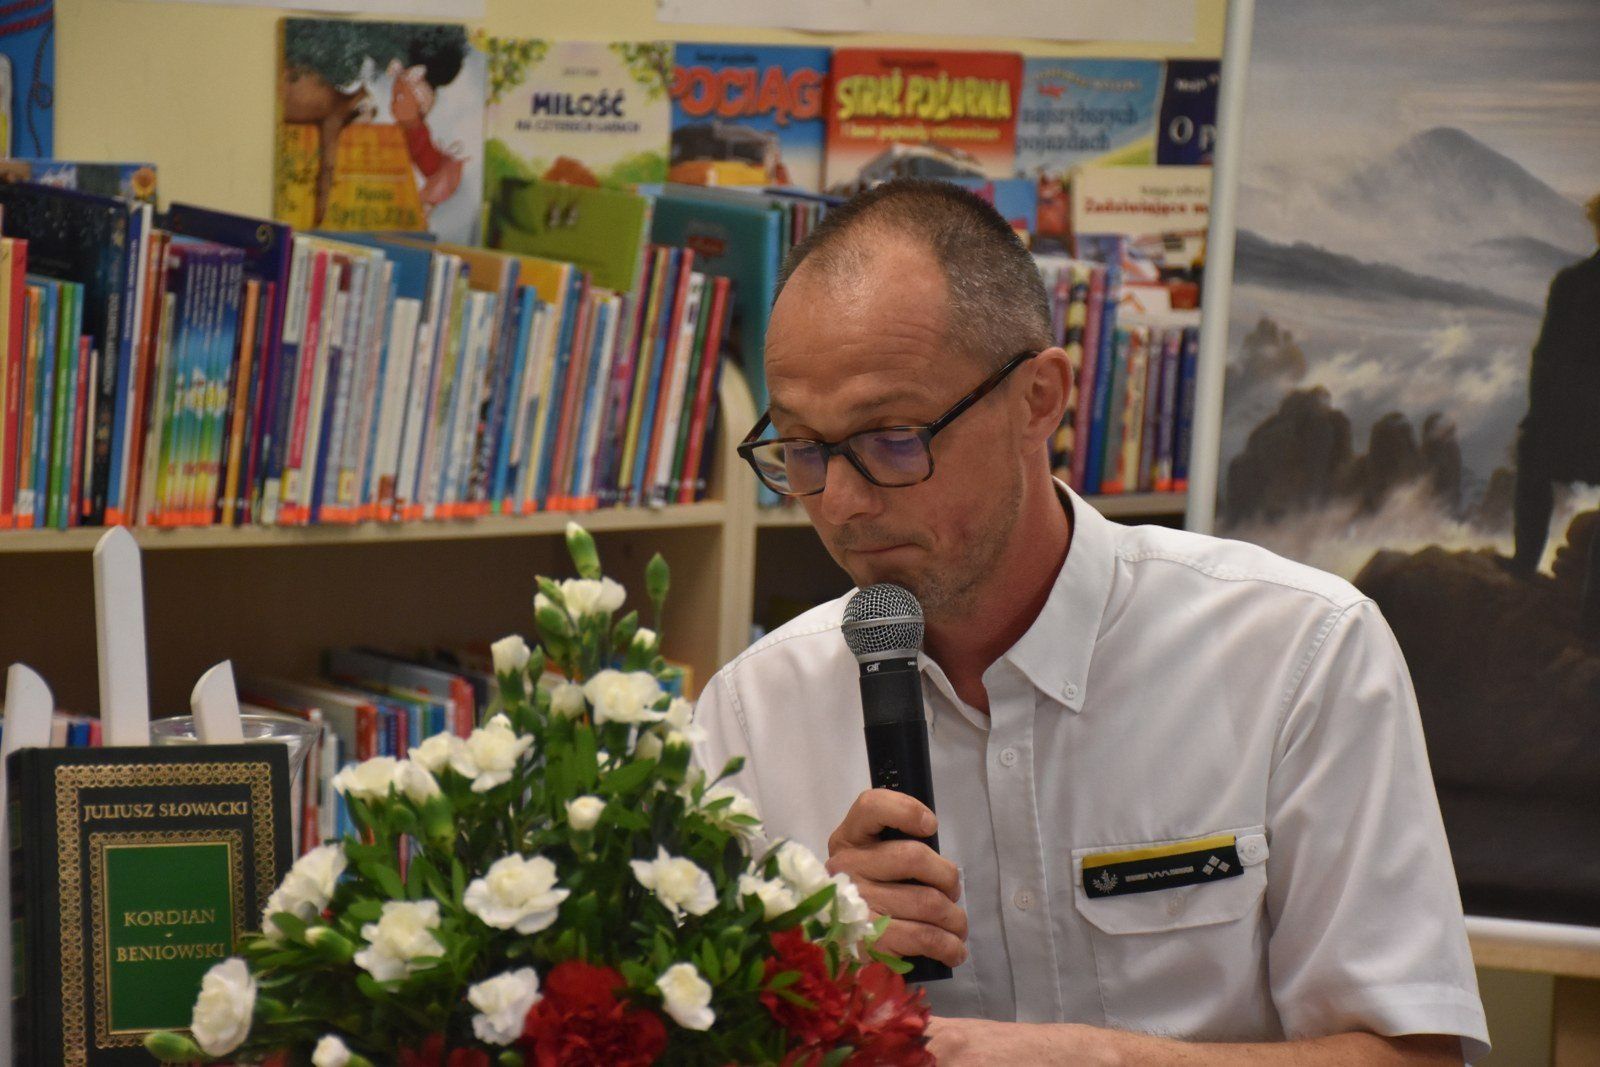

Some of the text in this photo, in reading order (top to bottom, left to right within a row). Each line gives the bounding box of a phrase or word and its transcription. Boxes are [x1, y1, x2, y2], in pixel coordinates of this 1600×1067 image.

[532, 88, 625, 116] MIŁOŚĆ
[837, 67, 902, 119] STRAŻ
[905, 71, 1012, 120] POŻARNA
[1168, 115, 1194, 145] O
[83, 800, 249, 823] JULIUSZ SŁOWACKI
[123, 908, 216, 928] KORDIAN
[115, 943, 225, 963] BENIOWSKI
